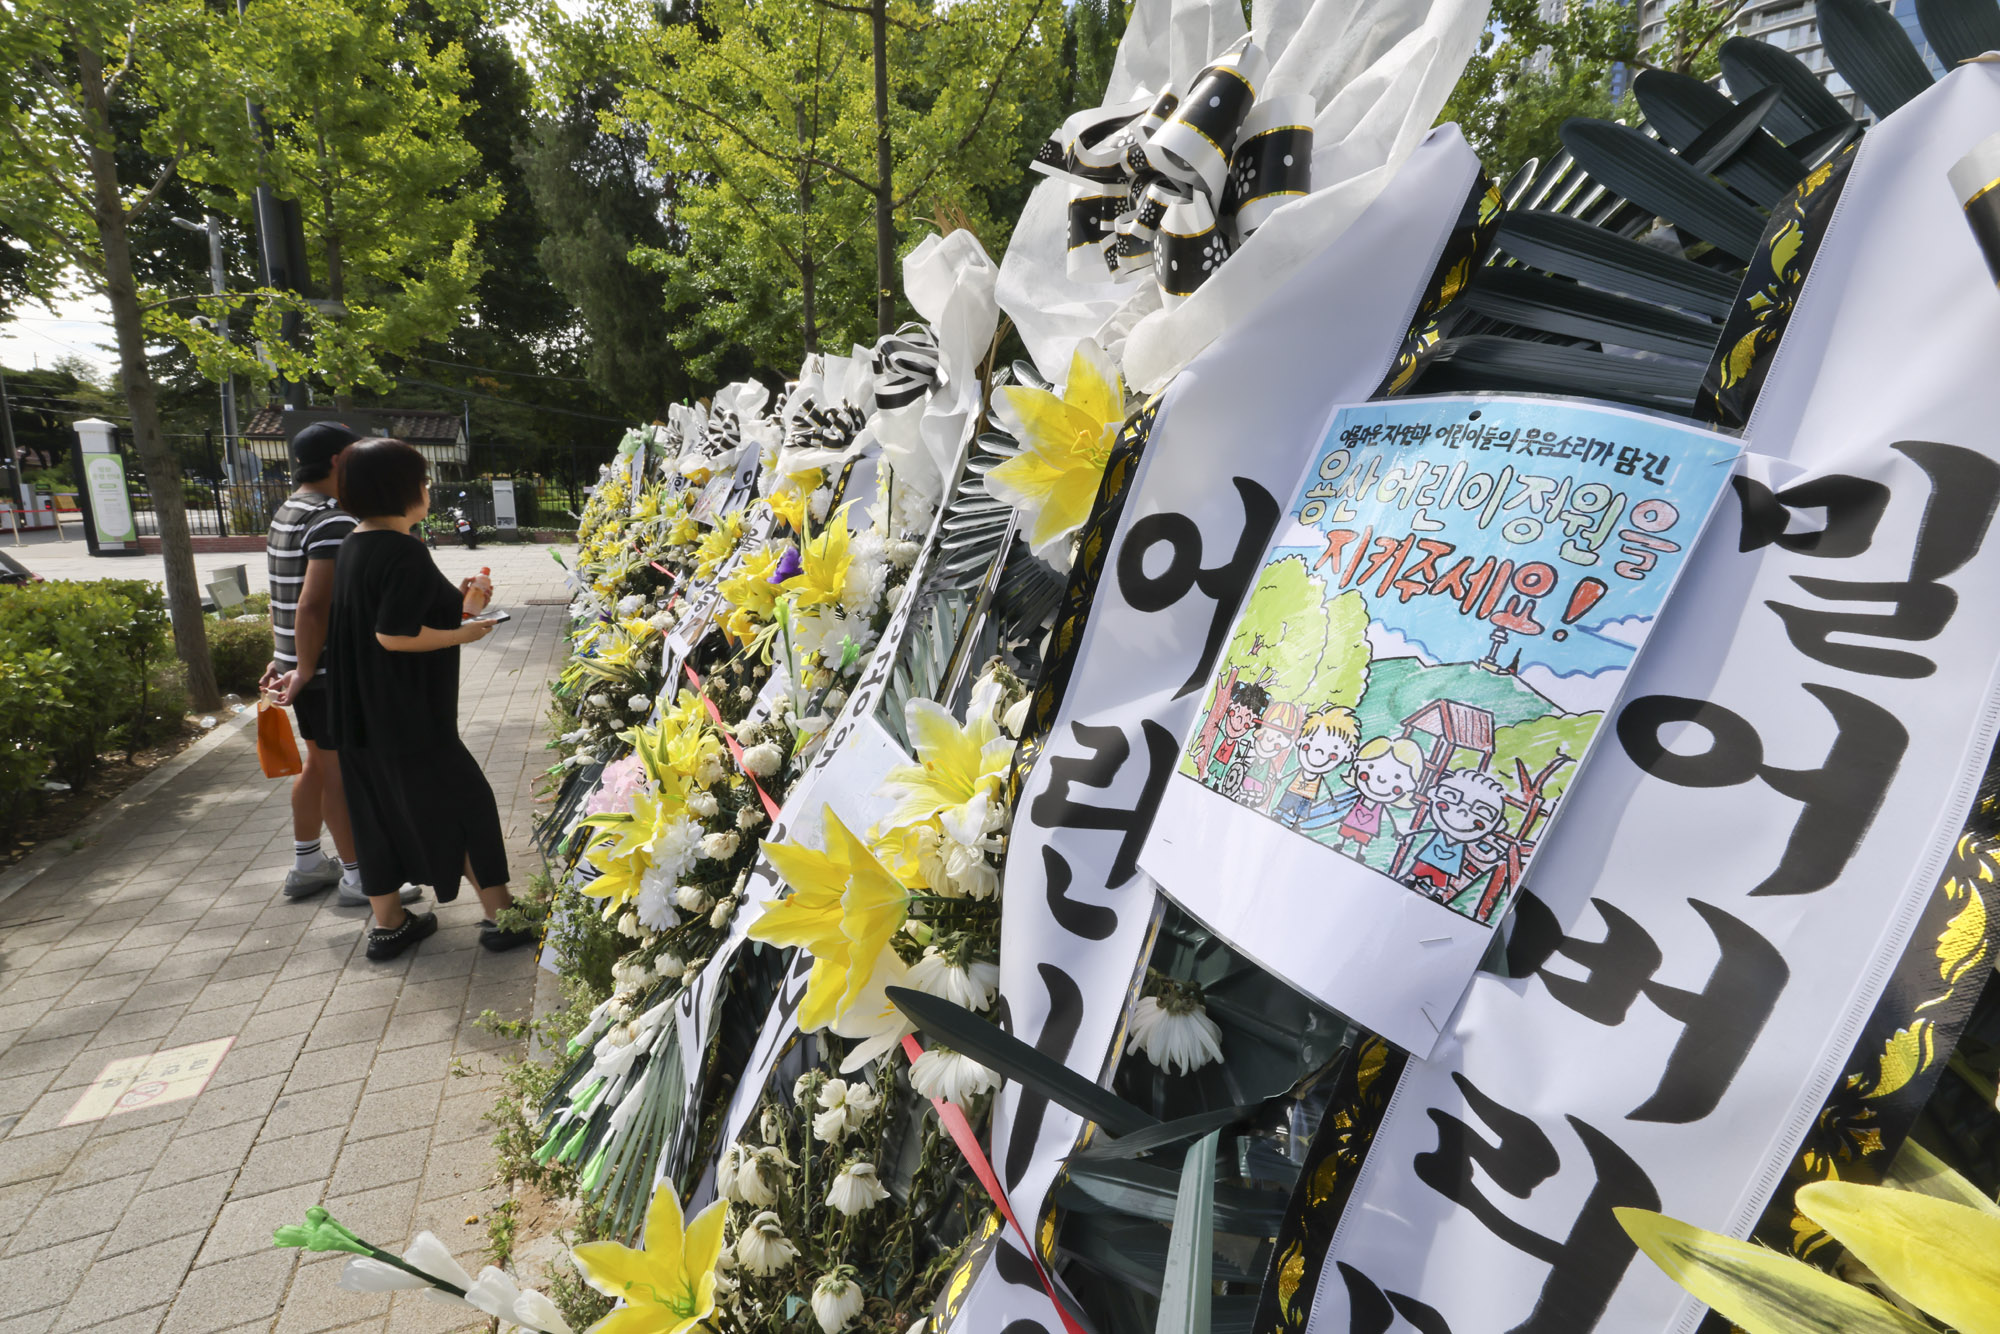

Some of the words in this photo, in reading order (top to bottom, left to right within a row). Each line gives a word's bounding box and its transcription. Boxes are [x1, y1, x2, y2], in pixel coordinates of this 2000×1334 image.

[1435, 423, 1520, 452] 어린이들의
[1517, 428, 1615, 467] 웃음소리가
[1613, 446, 1671, 486] 담긴
[1313, 524, 1608, 643] 지켜주세요!
